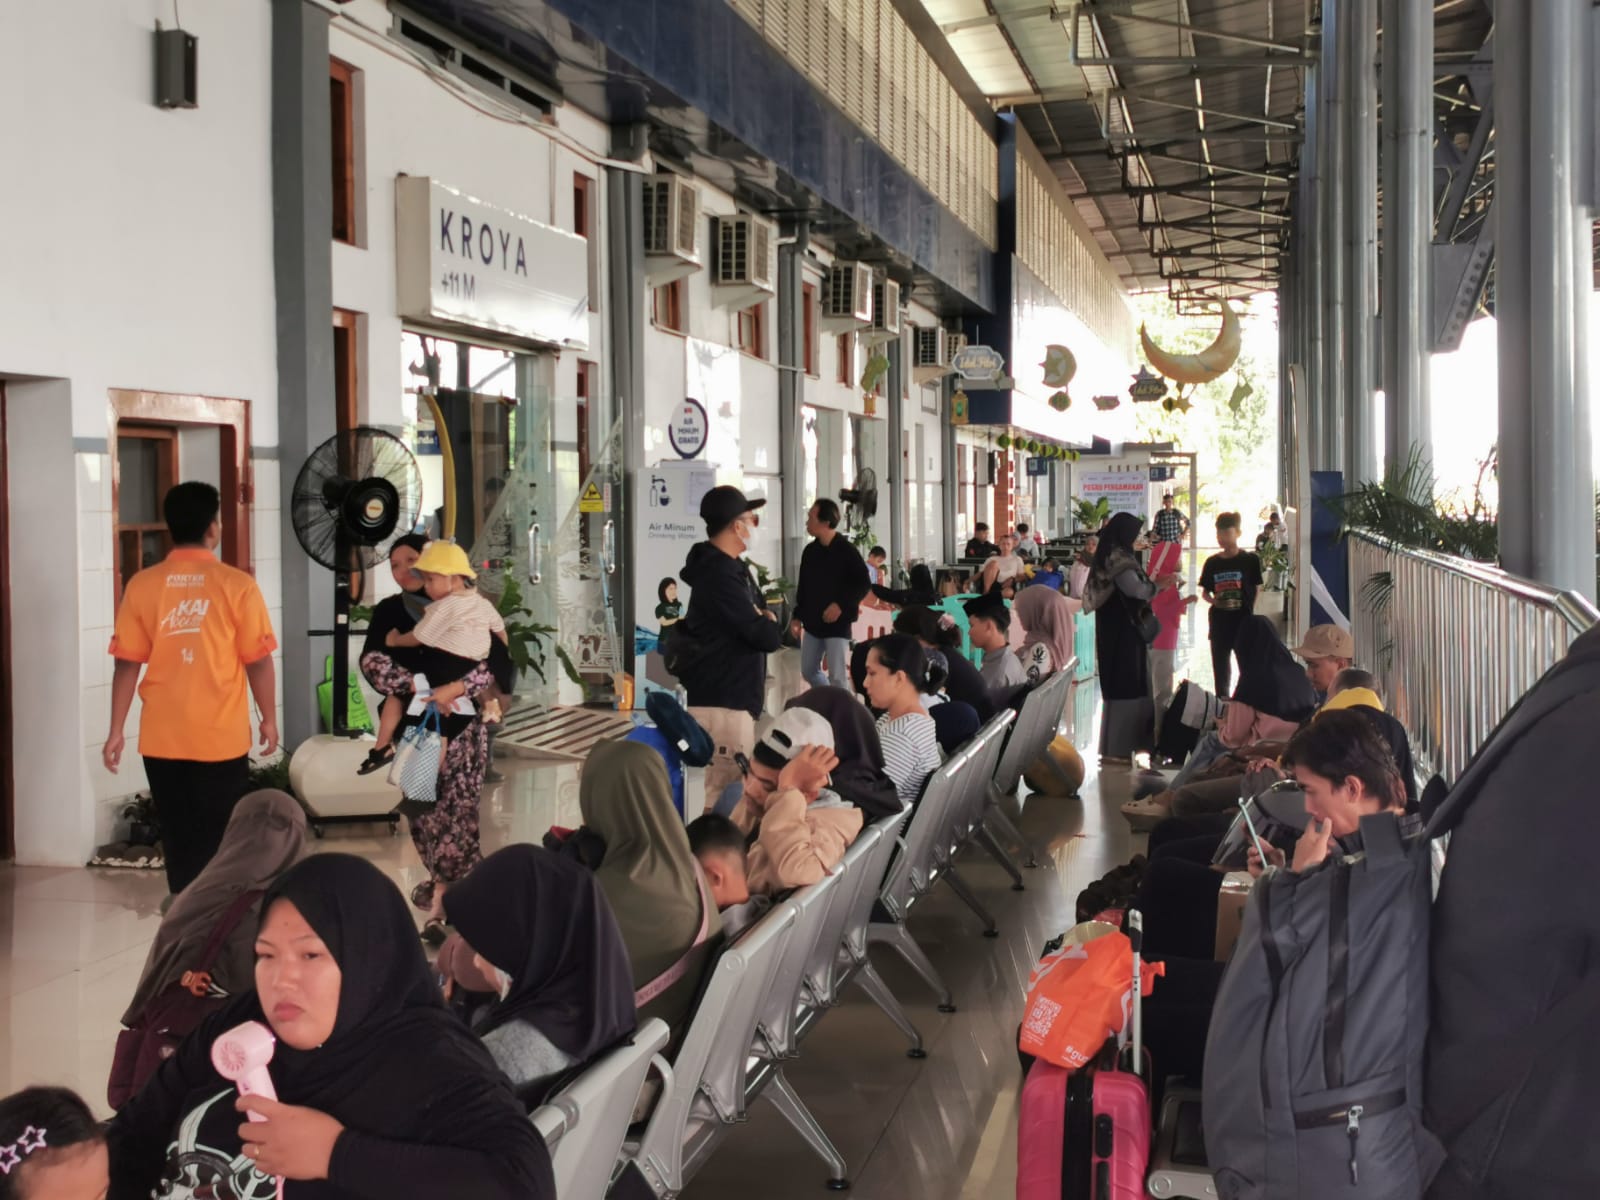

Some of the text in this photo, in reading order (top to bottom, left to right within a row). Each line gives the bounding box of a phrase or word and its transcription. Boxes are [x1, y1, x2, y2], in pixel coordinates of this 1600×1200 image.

[441, 207, 528, 277] KROYA
[463, 272, 476, 301] M
[678, 436, 699, 444] GRATIS
[648, 523, 695, 531] Air Minum
[178, 599, 210, 616] KAI
[181, 647, 195, 665] 14
